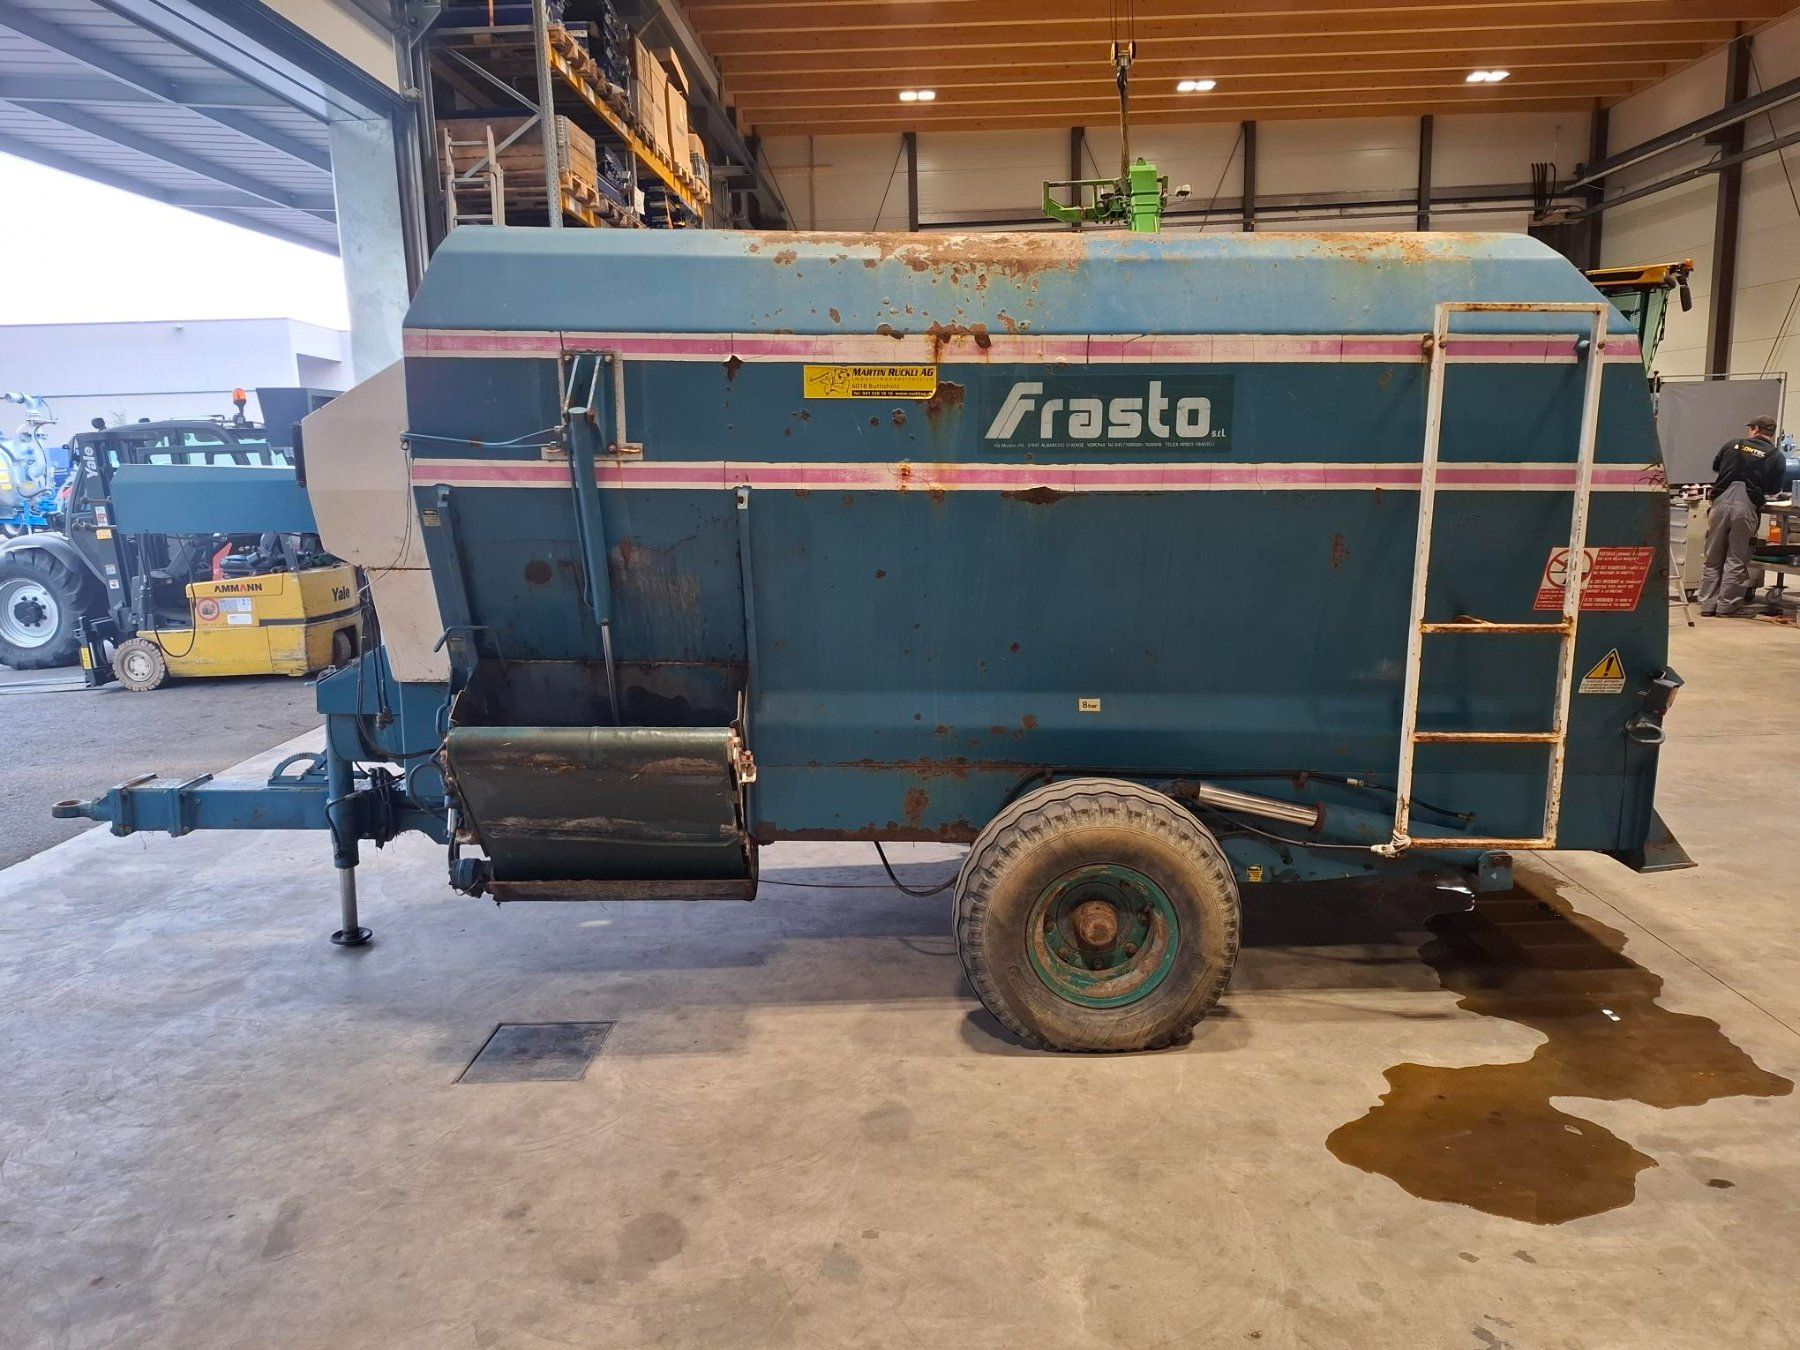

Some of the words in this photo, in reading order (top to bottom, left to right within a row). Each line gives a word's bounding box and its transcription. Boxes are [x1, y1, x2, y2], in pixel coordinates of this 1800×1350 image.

[852, 368, 886, 377] MARTIN
[920, 368, 934, 377] AG
[82, 446, 98, 479] Yale
[213, 582, 263, 594] AMMANN
[331, 585, 350, 602] Yale
